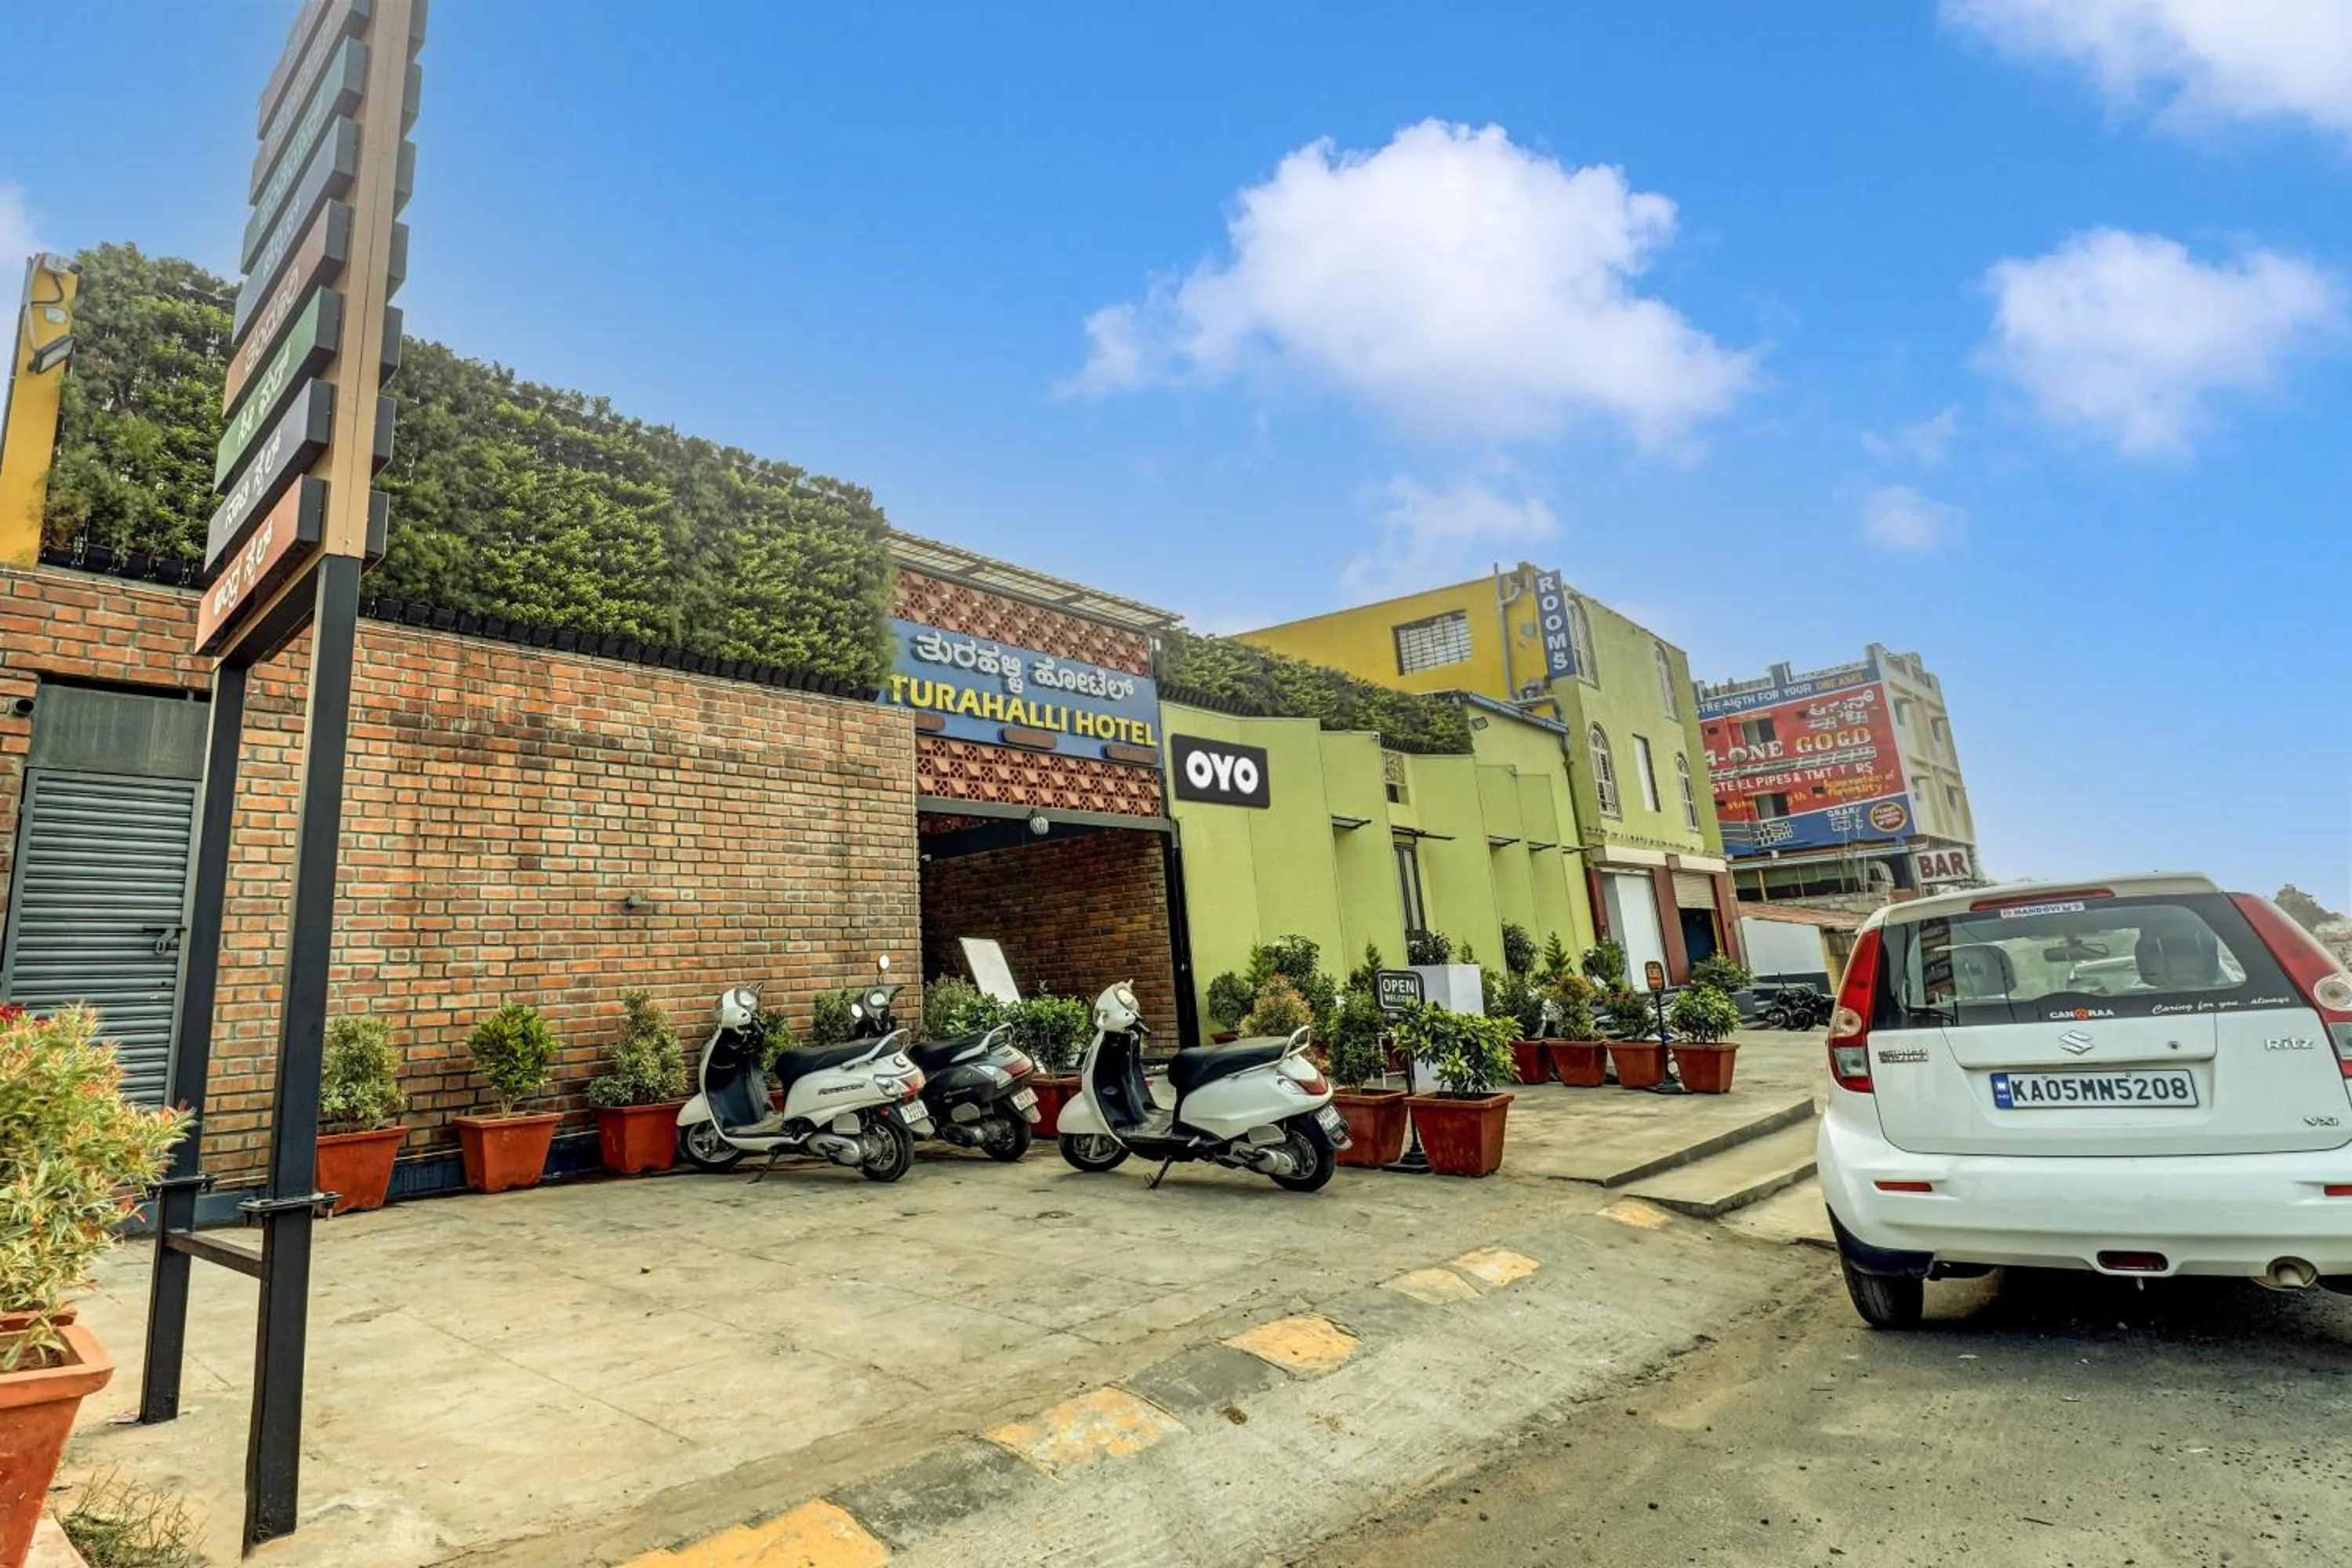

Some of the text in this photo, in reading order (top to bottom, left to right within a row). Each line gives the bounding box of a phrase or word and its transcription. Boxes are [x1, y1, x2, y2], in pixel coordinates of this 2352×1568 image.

[1538, 576, 1569, 671] ROOMS
[1783, 684, 1813, 699] YOUR
[890, 674, 1158, 745] TURAHALLI HOTEL
[1185, 750, 1258, 795] OYO
[1755, 773, 1791, 788] PIPES
[1804, 767, 1833, 781] TMT
[1918, 852, 1969, 878] BAR
[1382, 978, 1415, 993] OPEN
[2152, 1003, 2192, 1014] Caring
[2198, 1000, 2214, 1011] for
[2011, 1077, 2189, 1102] KA05MN5208
